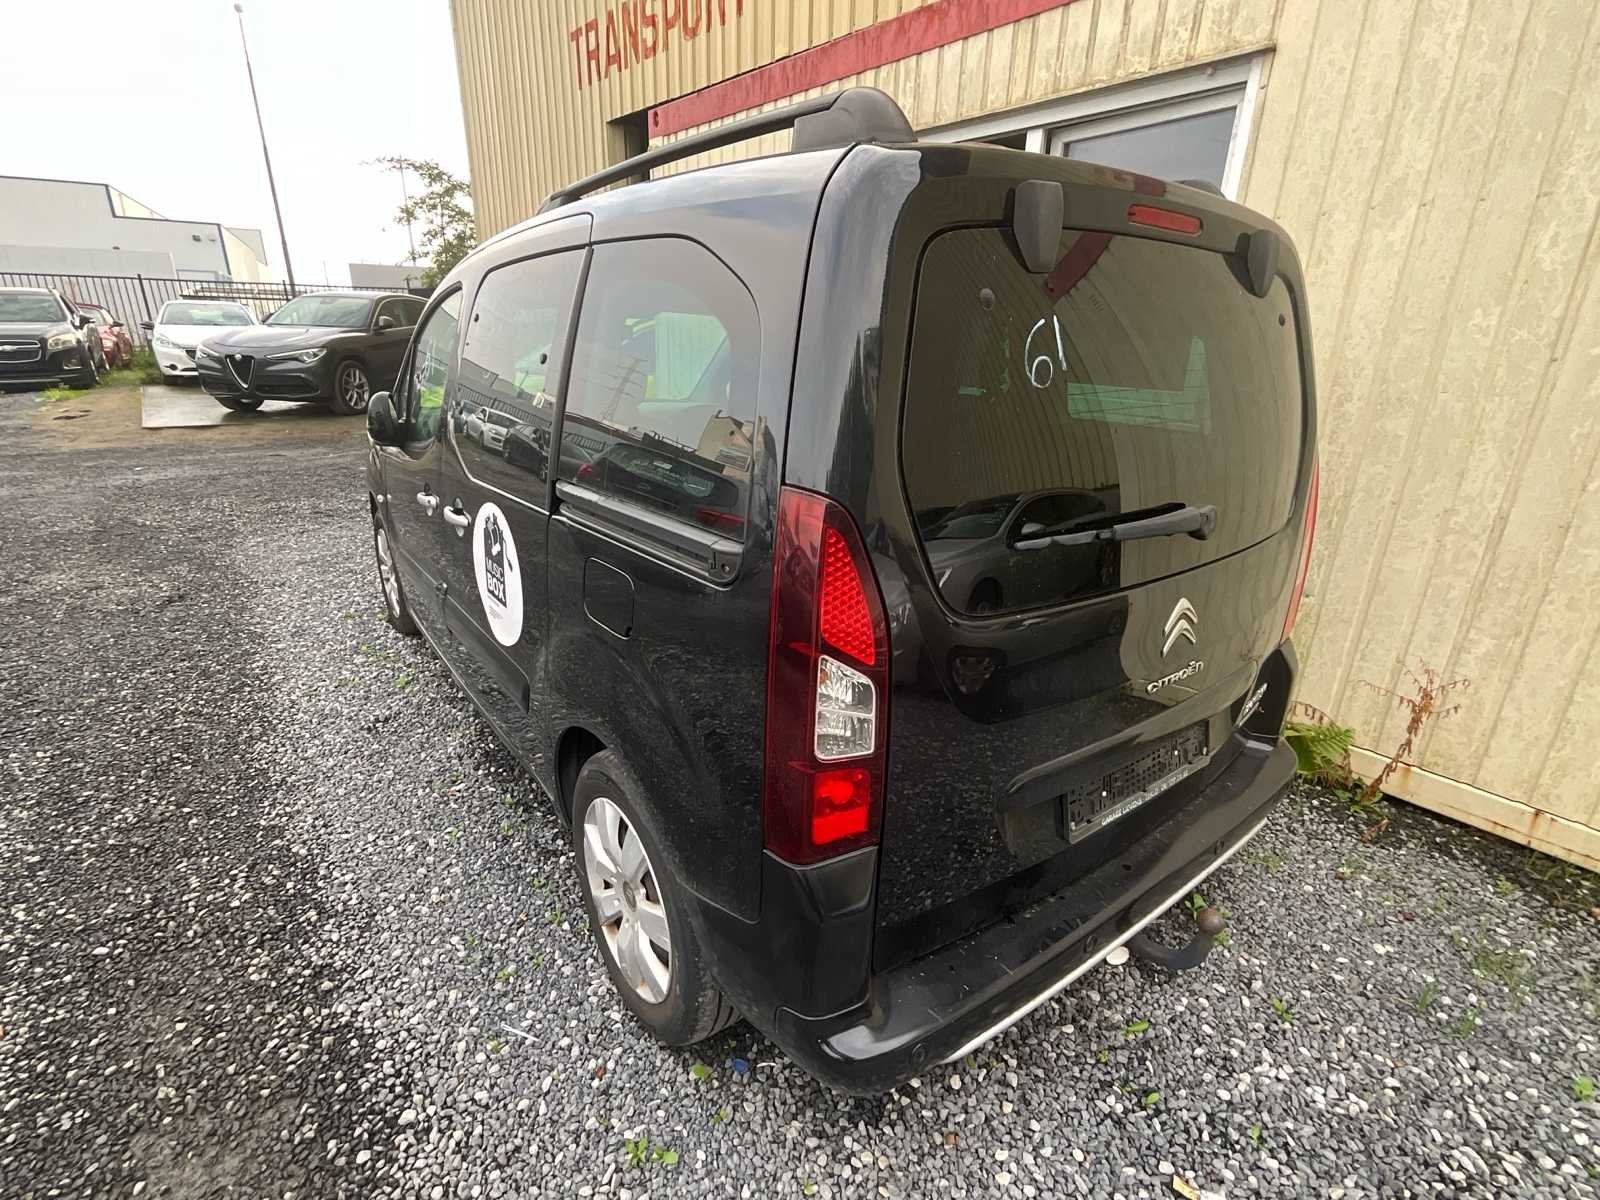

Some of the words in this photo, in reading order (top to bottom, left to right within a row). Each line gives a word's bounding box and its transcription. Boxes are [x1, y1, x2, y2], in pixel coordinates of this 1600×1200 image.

[570, 0, 744, 90] TRANSPO
[1024, 314, 1068, 388] 61
[487, 571, 506, 602] BOX
